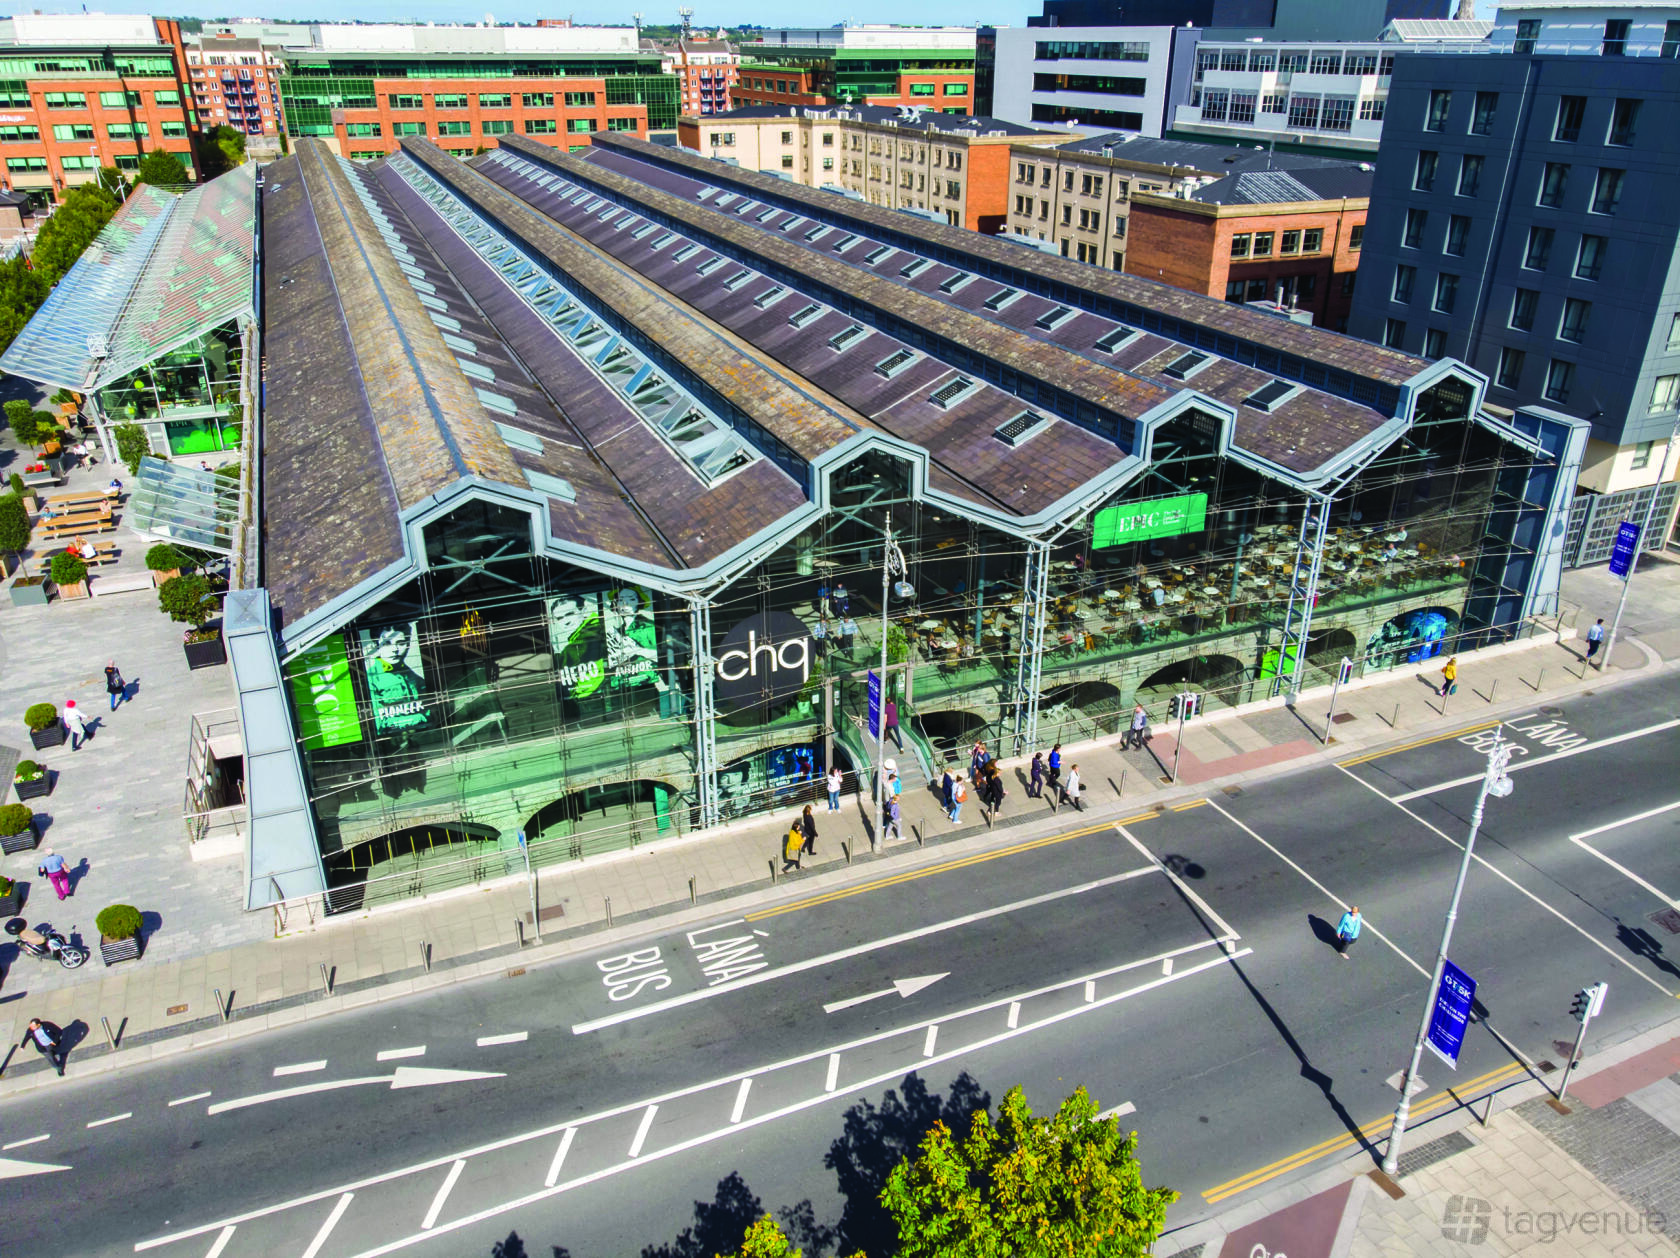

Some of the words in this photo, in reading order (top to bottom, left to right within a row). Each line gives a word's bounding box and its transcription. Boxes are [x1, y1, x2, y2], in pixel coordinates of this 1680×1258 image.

[1119, 512, 1160, 532] EPIC
[560, 661, 599, 686] HERO
[717, 630, 809, 683] chq
[596, 946, 672, 1001] BUS
[686, 919, 769, 986] LÁNA
